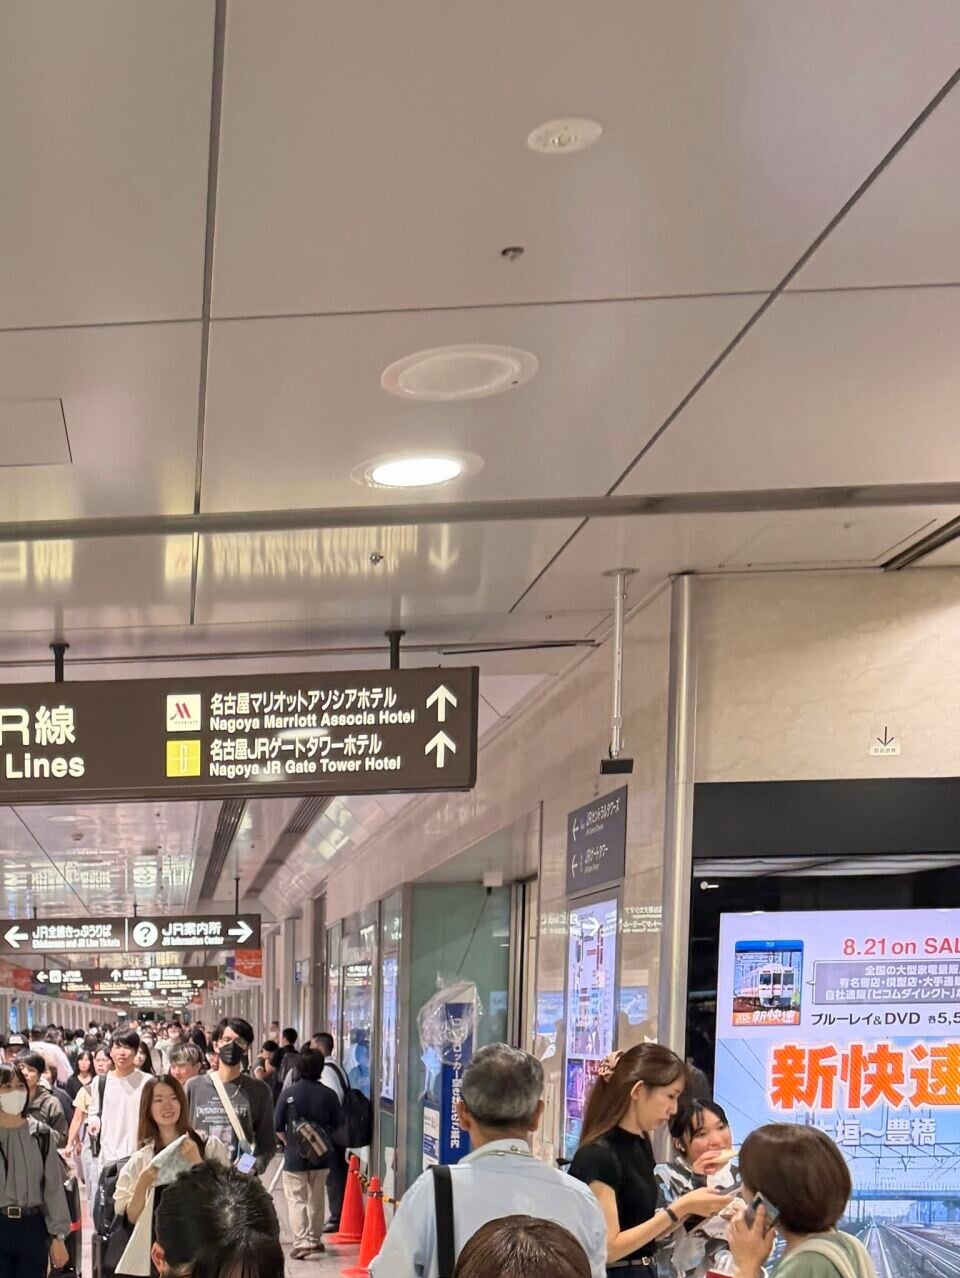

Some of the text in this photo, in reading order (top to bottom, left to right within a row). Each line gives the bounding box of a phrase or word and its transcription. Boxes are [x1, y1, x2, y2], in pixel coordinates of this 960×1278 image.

[210, 687, 397, 716] 名古屋マリオットアソシアホテル
[210, 709, 415, 733] Nagoya Marriott Associa Hotel
[210, 733, 382, 761] 名古屋JRゲートタワーホテル
[6, 752, 85, 778] Lines
[209, 755, 401, 779] Nagoya JR Gate Tower Hotel
[32, 924, 112, 939] JR全線きっぷうりば
[162, 921, 222, 936] JR案内所
[843, 938, 886, 956] 8.21
[891, 941, 917, 955] on
[865, 964, 960, 976] 全国の大型家電量販
[770, 1043, 960, 1110] 新快速
